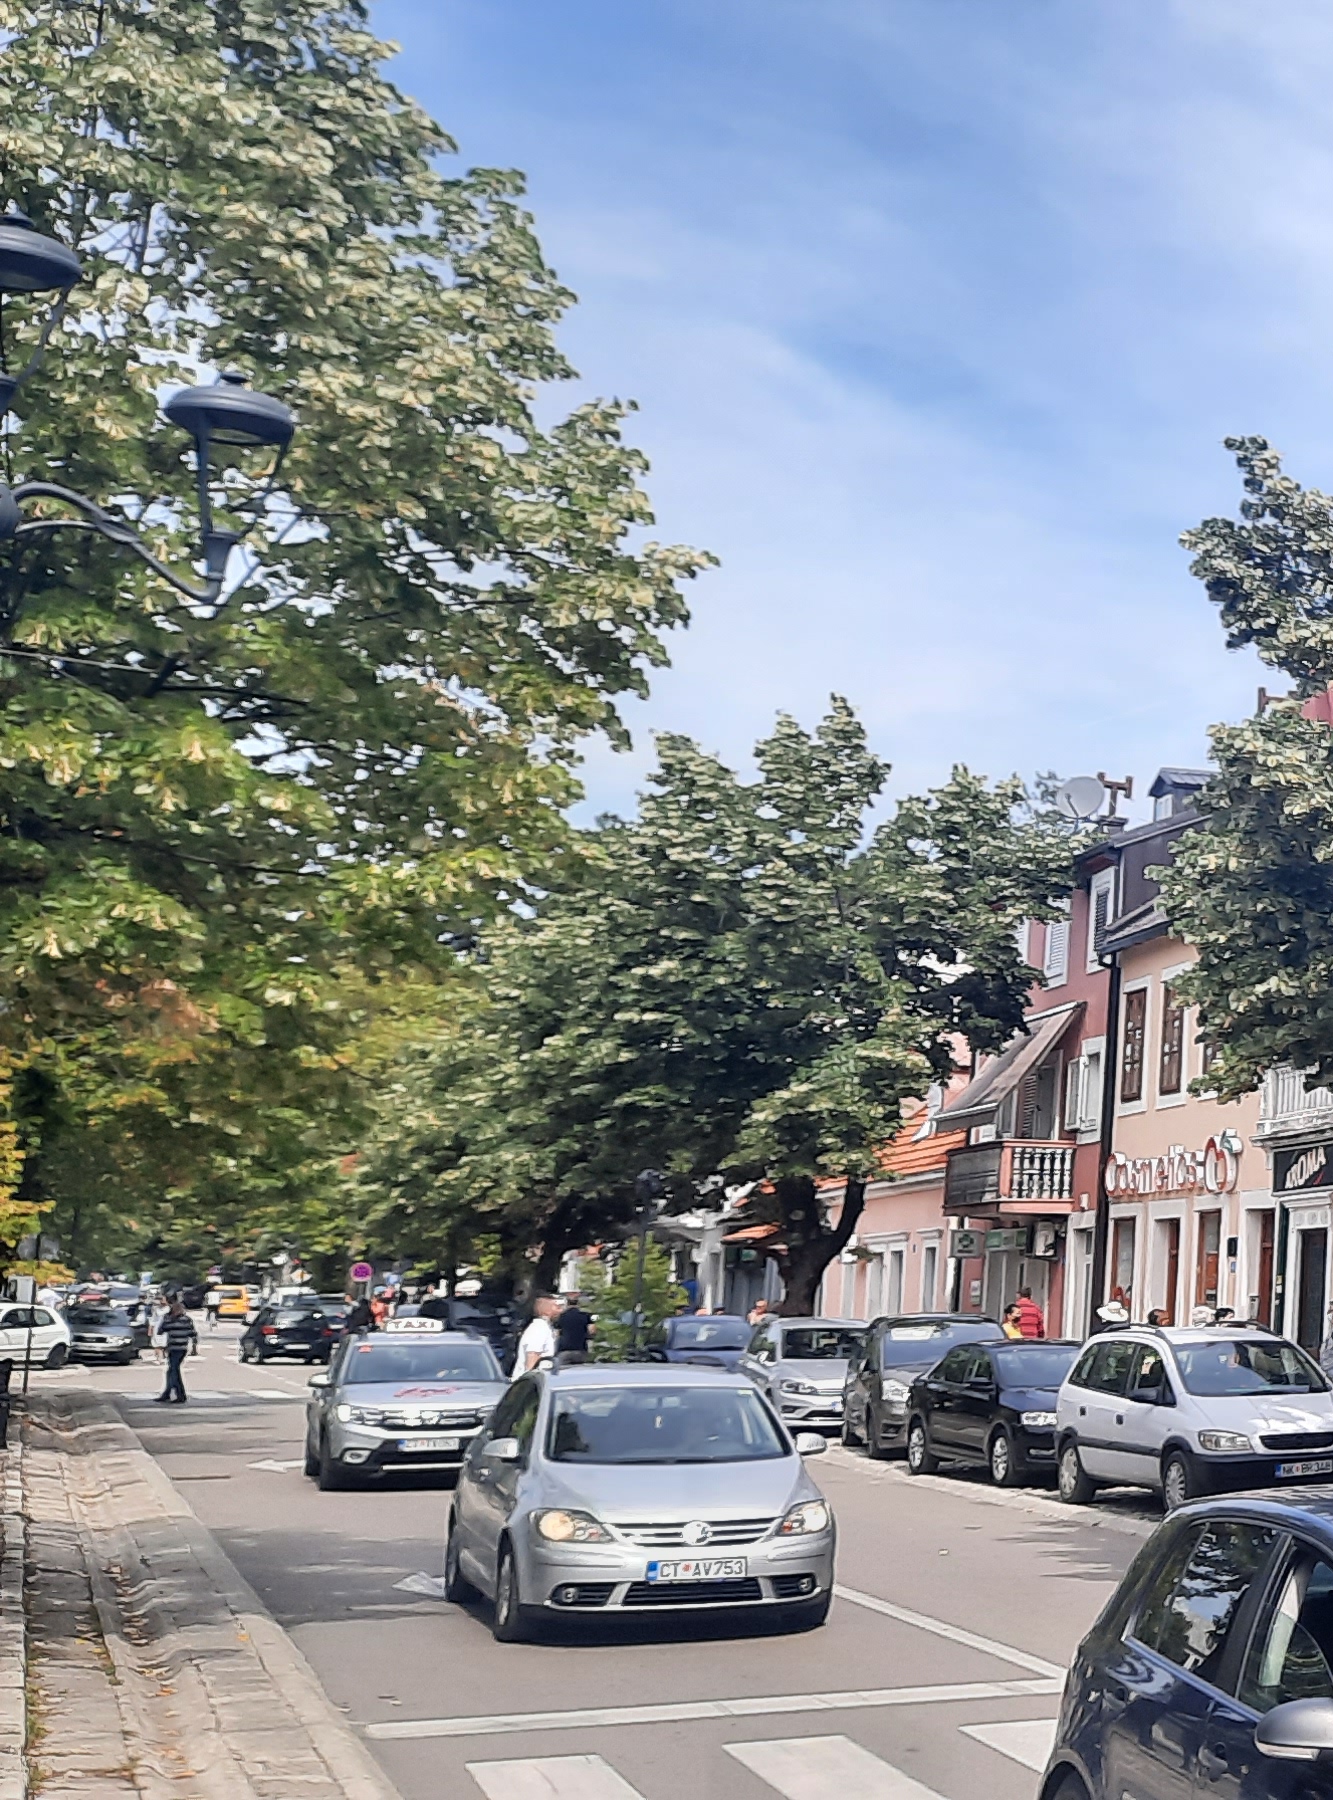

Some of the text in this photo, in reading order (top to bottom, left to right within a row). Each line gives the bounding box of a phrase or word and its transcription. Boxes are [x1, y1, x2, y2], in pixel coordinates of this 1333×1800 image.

[1284, 1146, 1327, 1189] AROMA
[391, 1320, 435, 1329] TAXI
[660, 1560, 743, 1578] CT AV753
